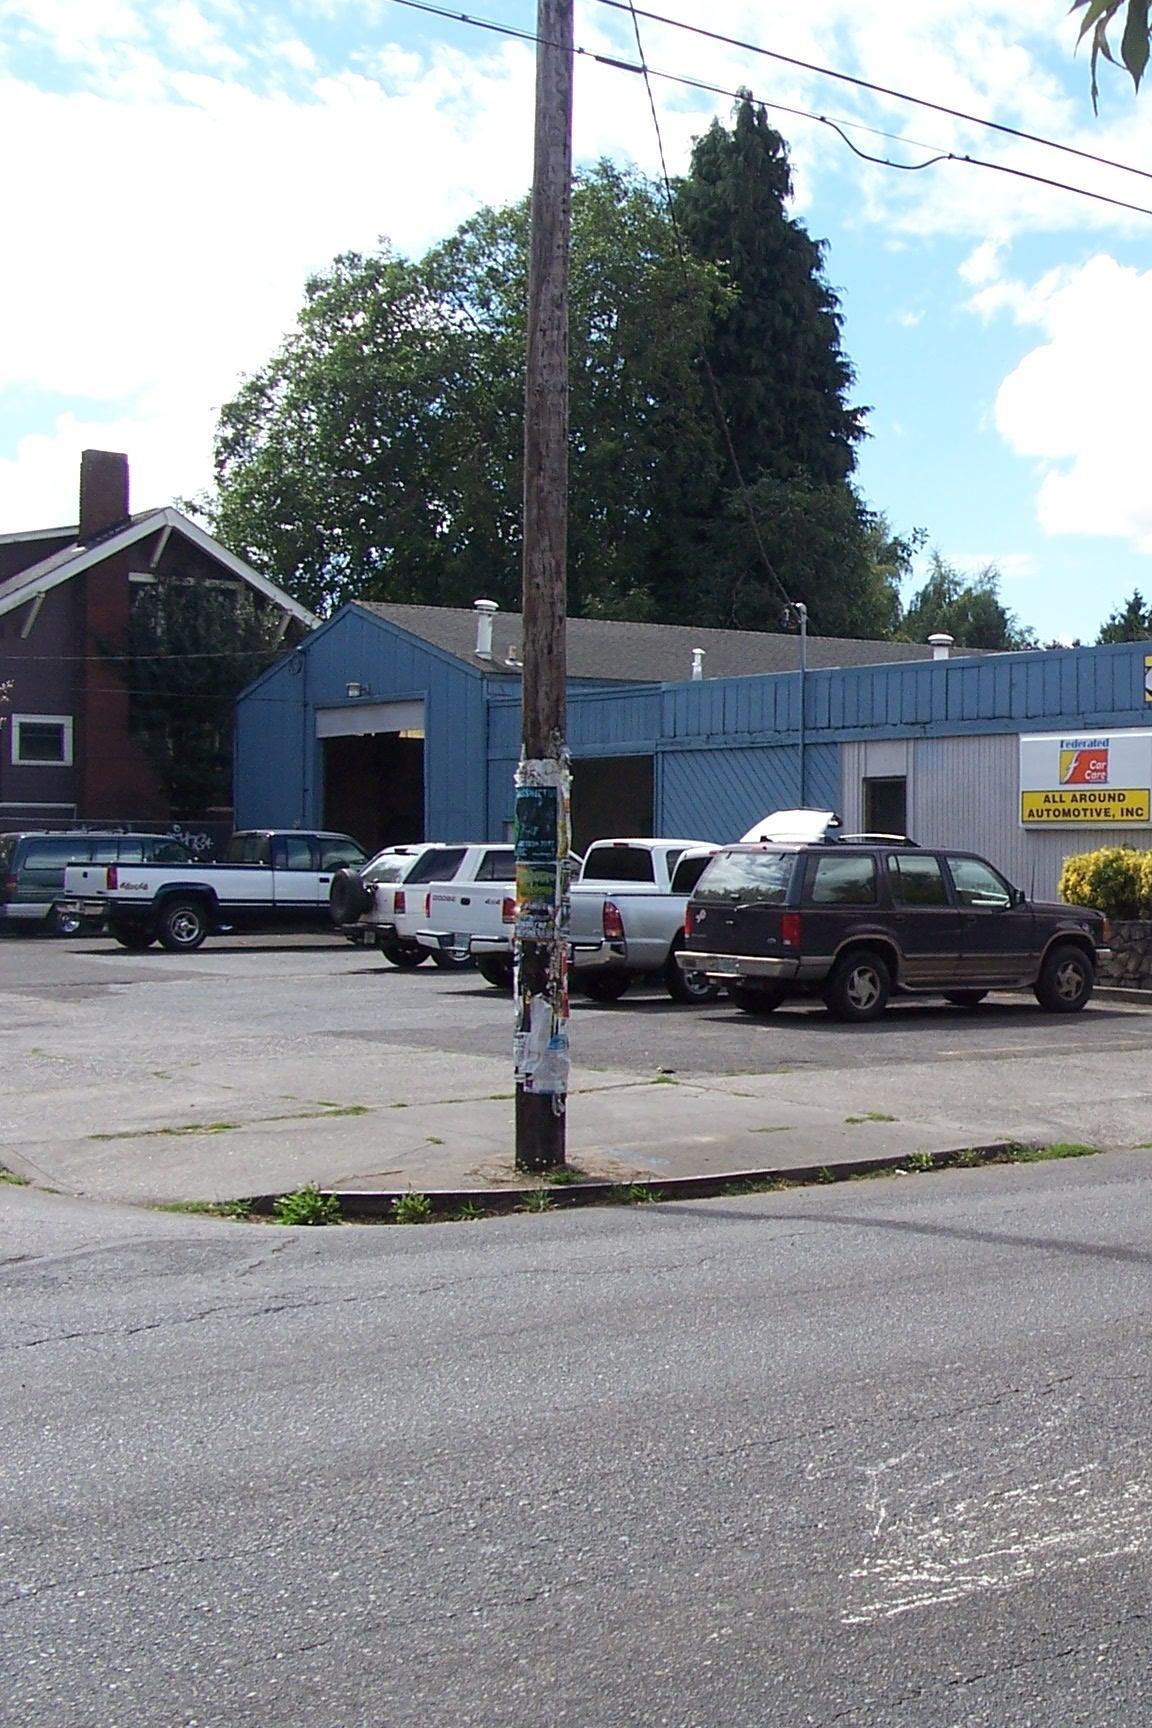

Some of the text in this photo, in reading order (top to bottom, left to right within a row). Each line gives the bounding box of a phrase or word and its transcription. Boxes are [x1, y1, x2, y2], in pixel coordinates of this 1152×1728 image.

[1060, 738, 1110, 749] Federated
[1089, 759, 1107, 770] Car
[1084, 770, 1107, 781] Care
[1043, 792, 1126, 804] ALL AROUND
[1027, 806, 1145, 819] AUTOMOTIVE, INC
